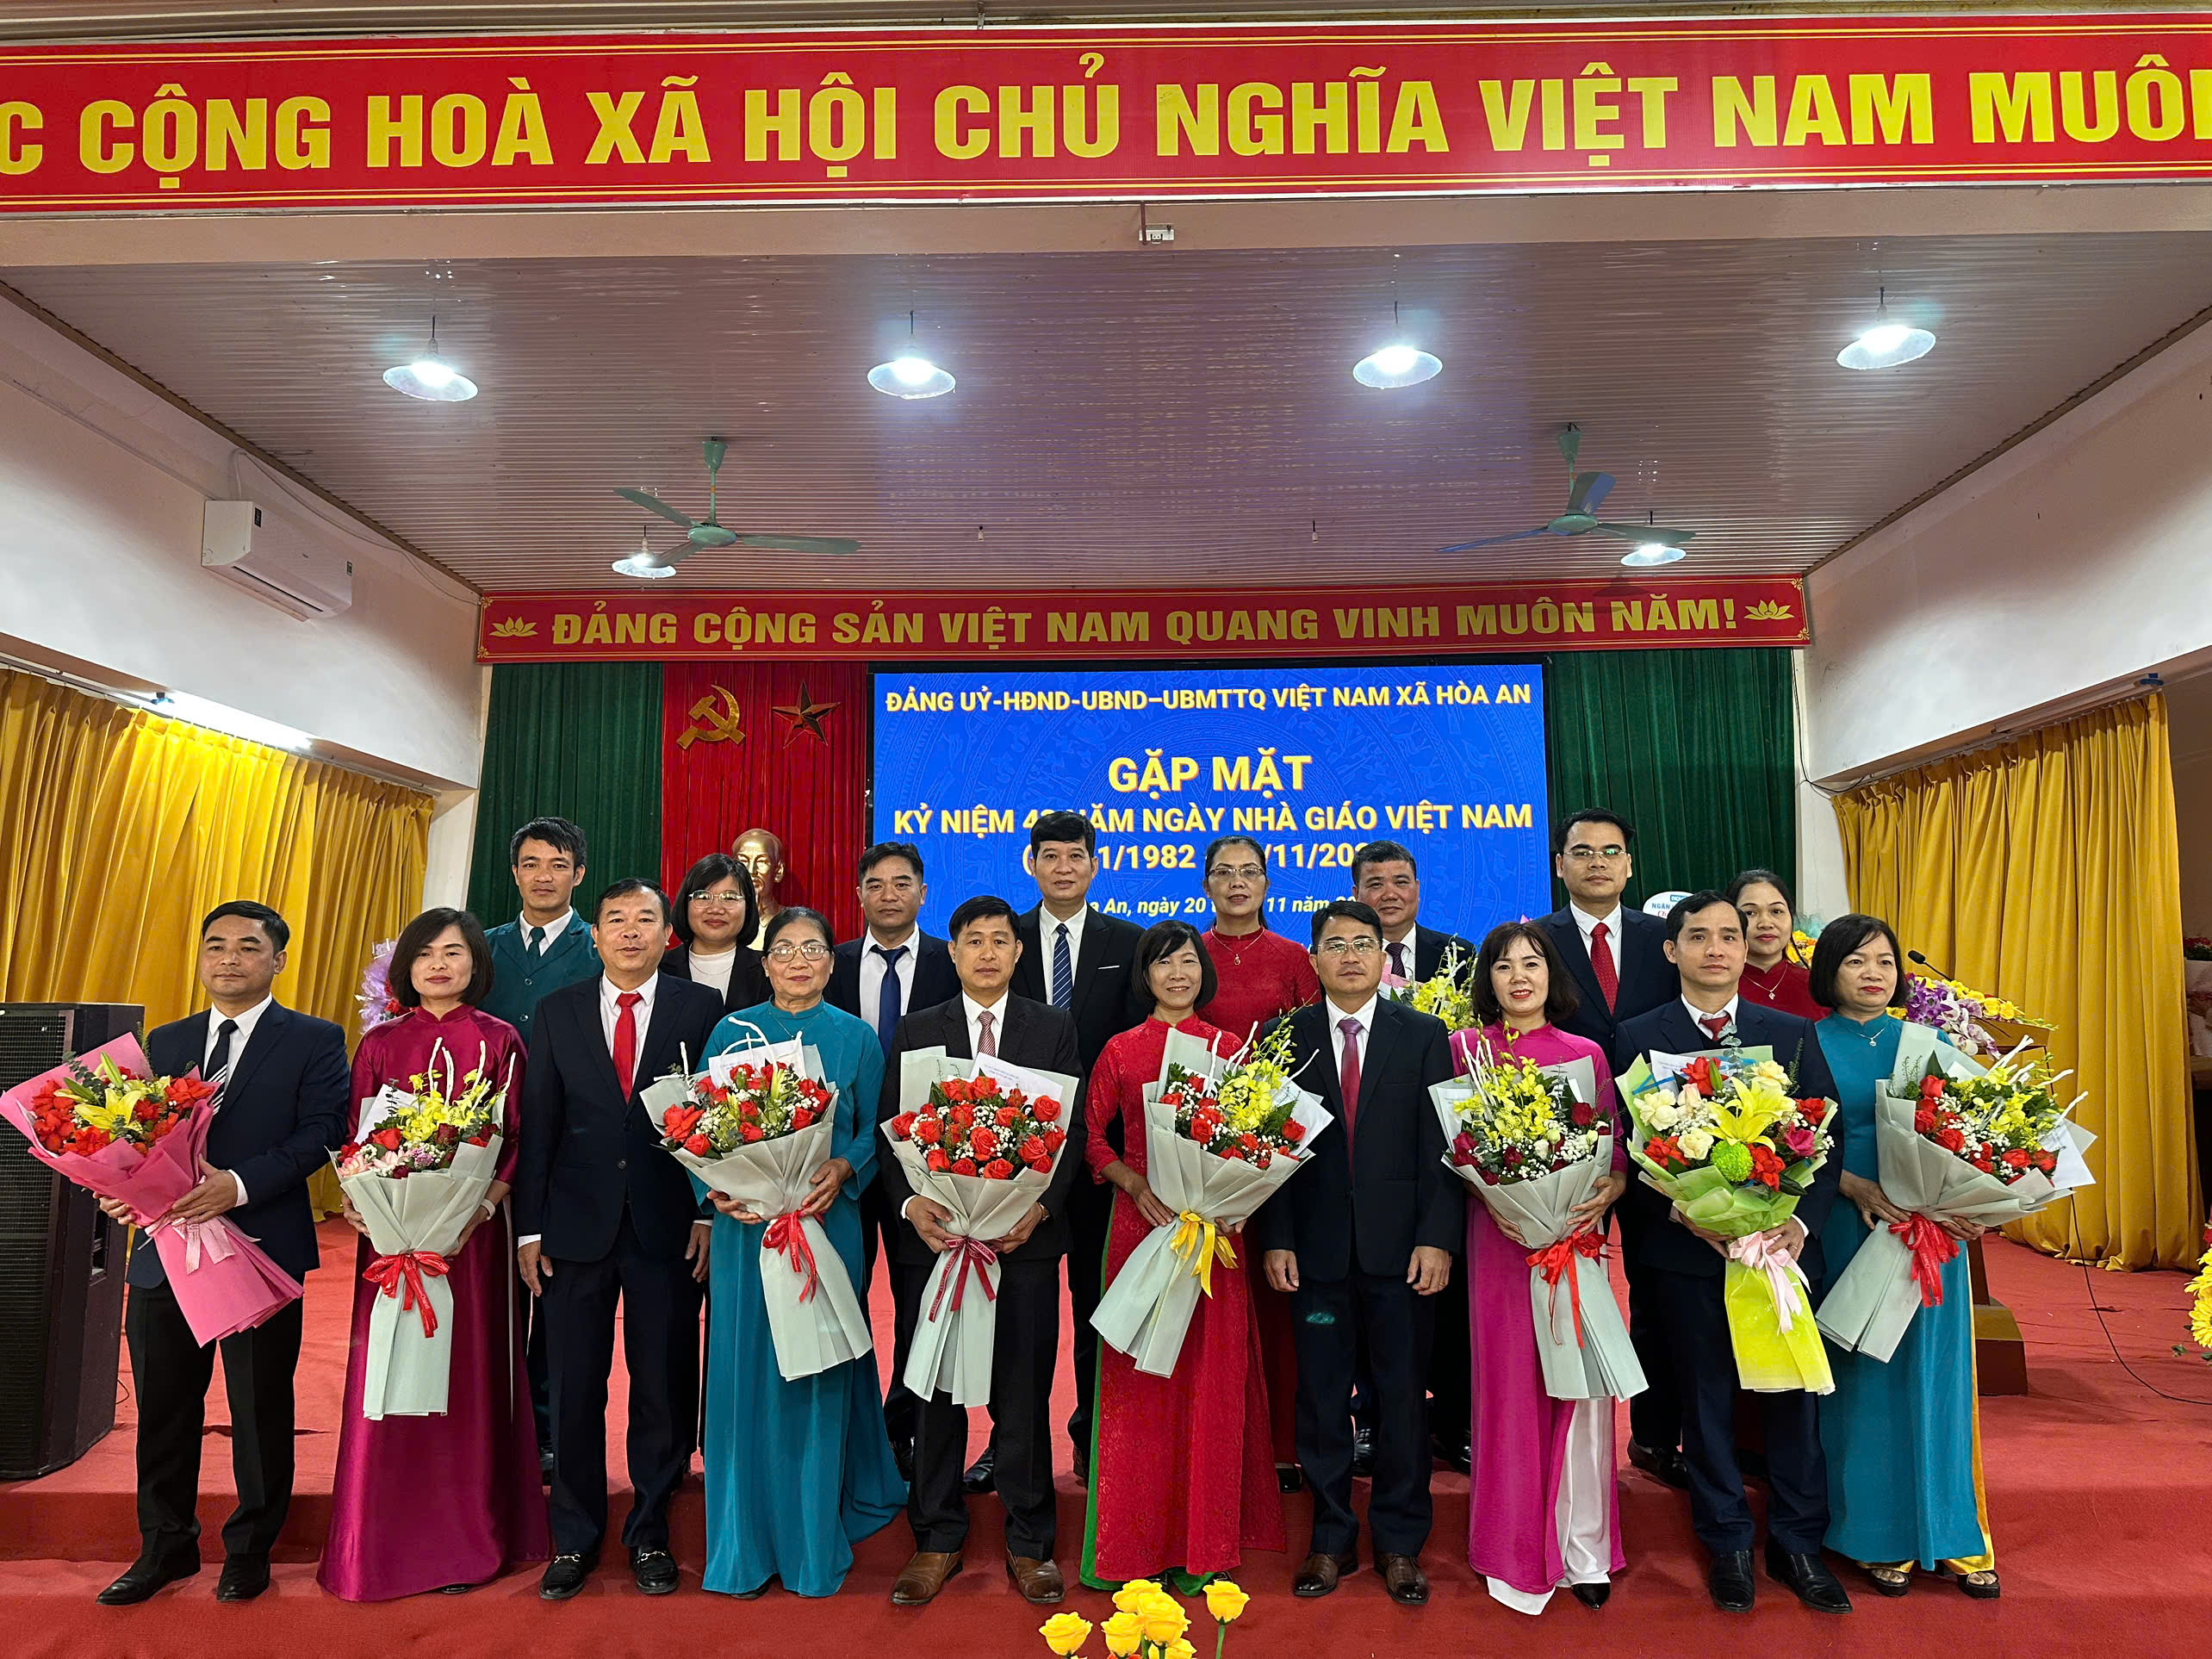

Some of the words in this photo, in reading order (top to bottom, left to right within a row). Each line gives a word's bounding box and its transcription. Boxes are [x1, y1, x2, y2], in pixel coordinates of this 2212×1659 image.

[79, 84, 331, 189] CỘNG
[367, 78, 554, 168] HOÀ
[585, 76, 711, 165] XÃ
[744, 72, 897, 177] HỘI
[934, 53, 1120, 160] CHỦ
[1156, 66, 1450, 157] NGHĨA
[1478, 62, 1679, 166] VIỆT
[1712, 73, 1935, 147] NAM
[552, 600, 677, 644] ĐẢNG
[693, 606, 817, 650] CỘNG
[832, 600, 924, 644] SẢN
[939, 606, 1032, 649] VIỆT
[1047, 612, 1150, 643] NAM
[1166, 609, 1318, 644] QUANG
[1333, 606, 1440, 639] VINH
[1457, 596, 1595, 637] MUÔN
[1610, 593, 1737, 631] NĂM!
[885, 686, 954, 712] ĐẢNG
[1272, 683, 1327, 711] VIỆT
[1333, 687, 1390, 707] NAM
[1395, 680, 1432, 706] XÃ
[1437, 680, 1490, 705] HÒA
[1495, 683, 1532, 705] AN
[1108, 748, 1200, 799] GẶP
[1212, 747, 1313, 799] MẶT
[894, 803, 934, 835] KỶ
[941, 804, 1015, 839] NIỆM
[1022, 809, 1055, 830] 4
[1066, 803, 1134, 833] ĂM
[1142, 802, 1226, 833] NGÀY
[1233, 801, 1299, 832] NHÀ
[1305, 800, 1378, 831] GIÁO
[1384, 799, 1454, 835] VIỆT
[1461, 804, 1532, 830] NAM
[1103, 898, 1132, 917] An,
[1137, 897, 1180, 917] ngày
[1184, 897, 1207, 913] 20
[1267, 897, 1286, 912] 11
[1291, 896, 1330, 912] năm
